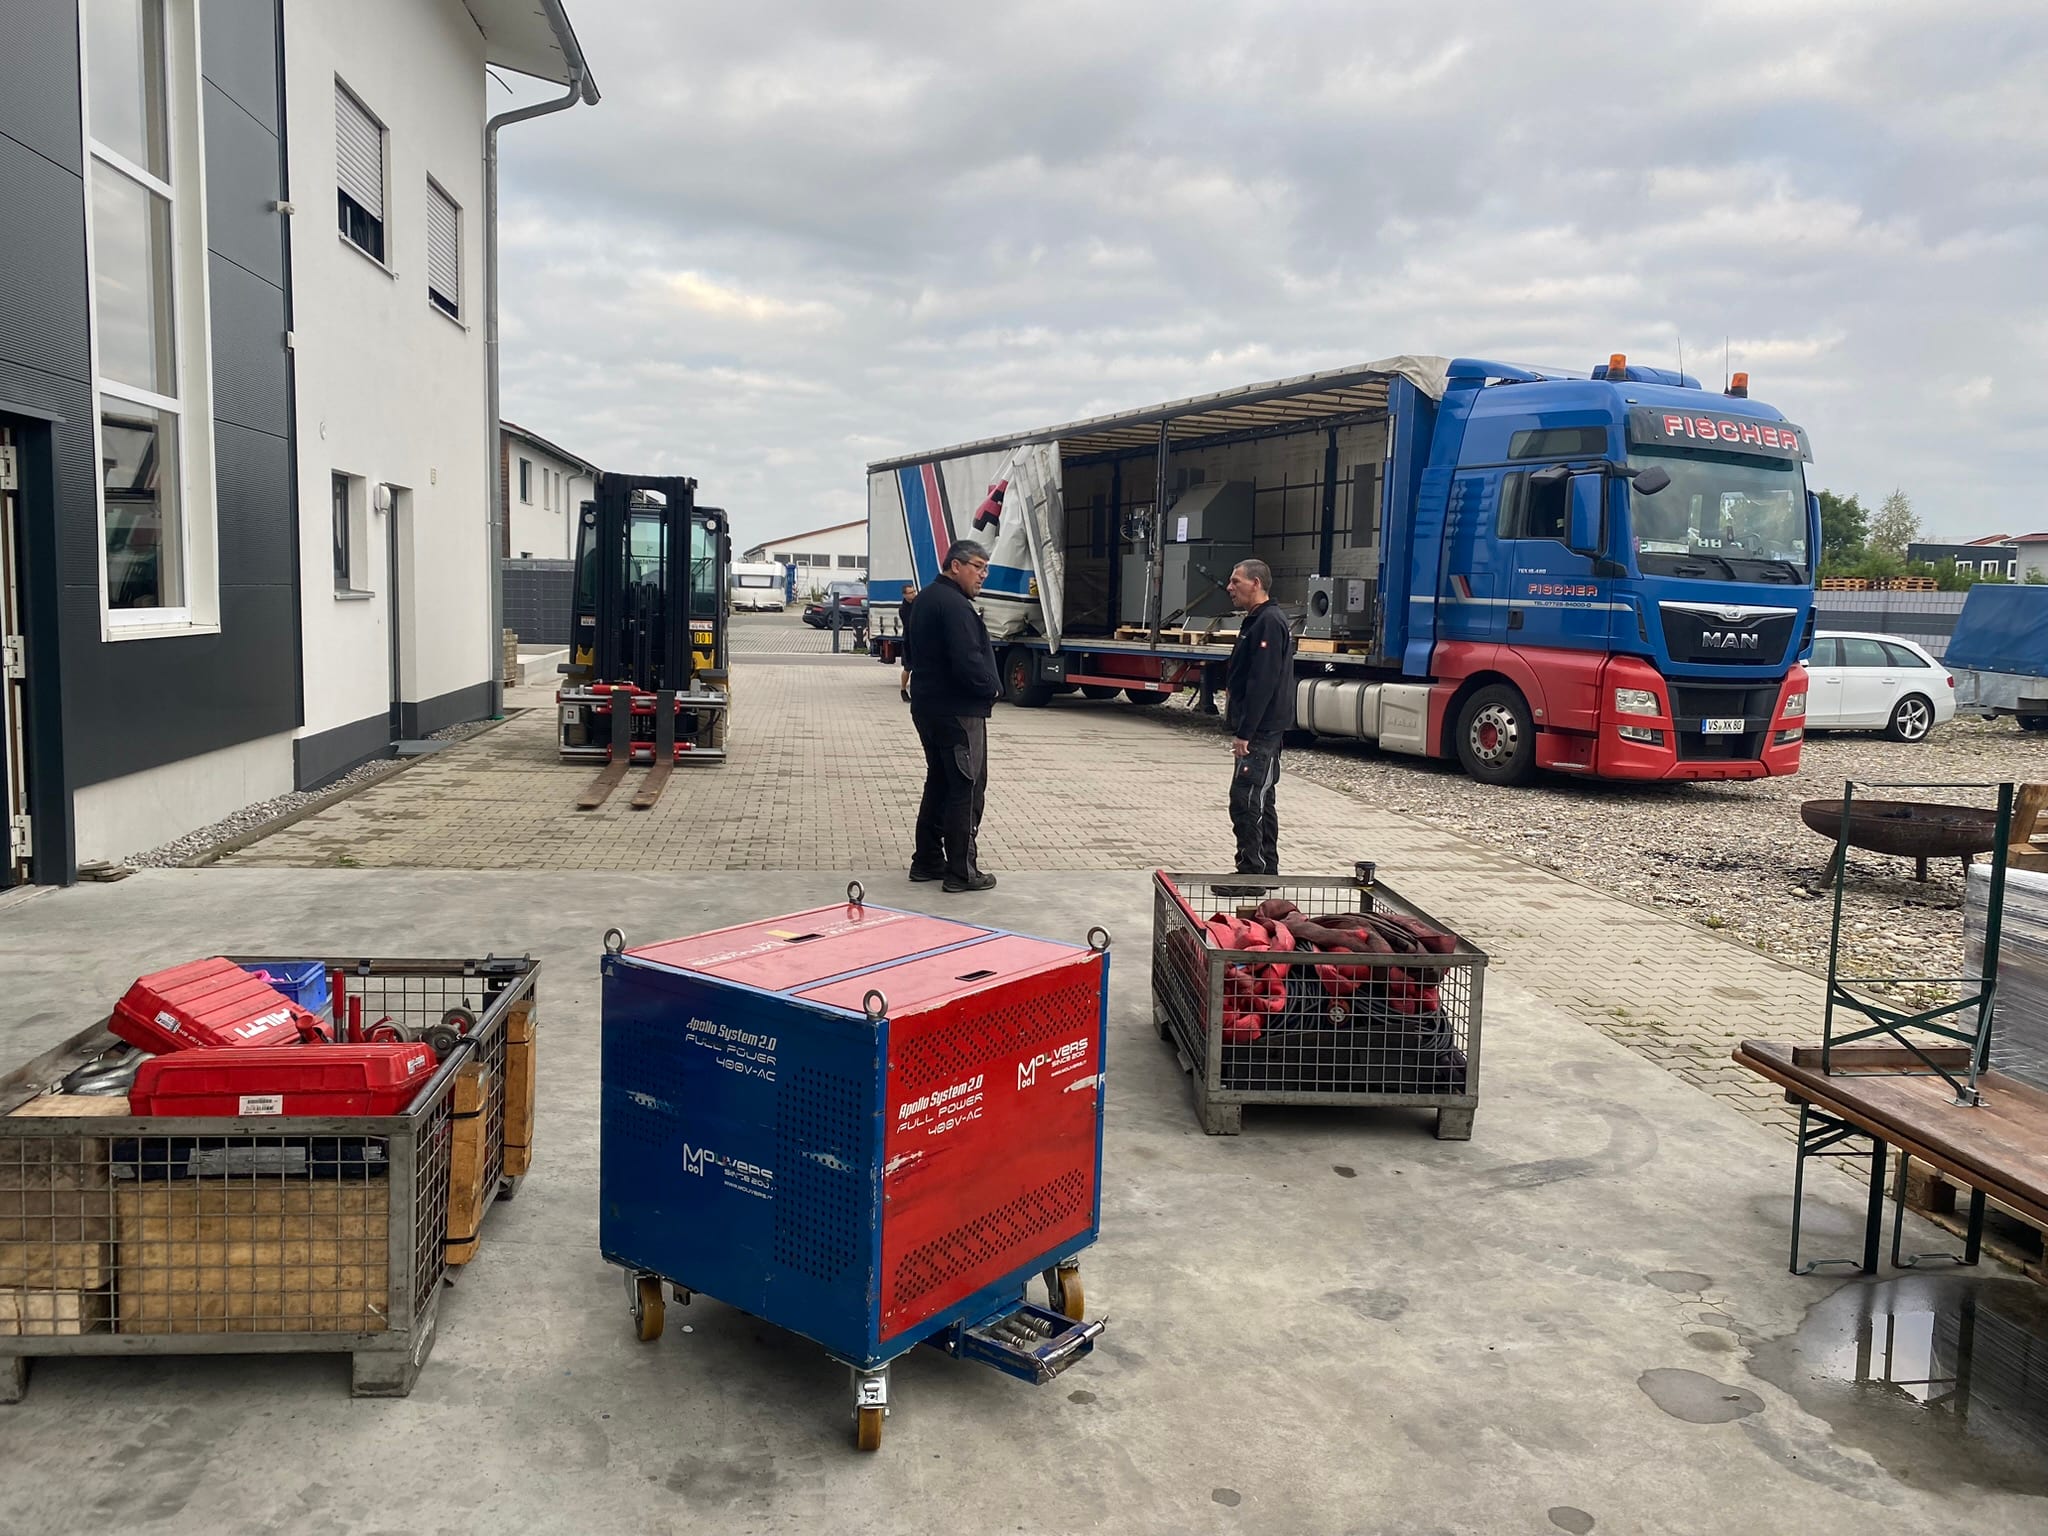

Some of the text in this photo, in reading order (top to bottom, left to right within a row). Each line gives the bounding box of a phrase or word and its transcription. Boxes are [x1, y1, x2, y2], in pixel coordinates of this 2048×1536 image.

[1663, 415, 1799, 451] FISCHER
[1528, 583, 1598, 597] FISCHER
[1702, 631, 1759, 650] MAN
[1708, 720, 1719, 730] VS
[685, 1033, 777, 1066] FULL POWER
[686, 1016, 777, 1051] Apollo System 2.0
[898, 1073, 984, 1119] Apollo System 2.0
[896, 1092, 983, 1135] FULL POWER
